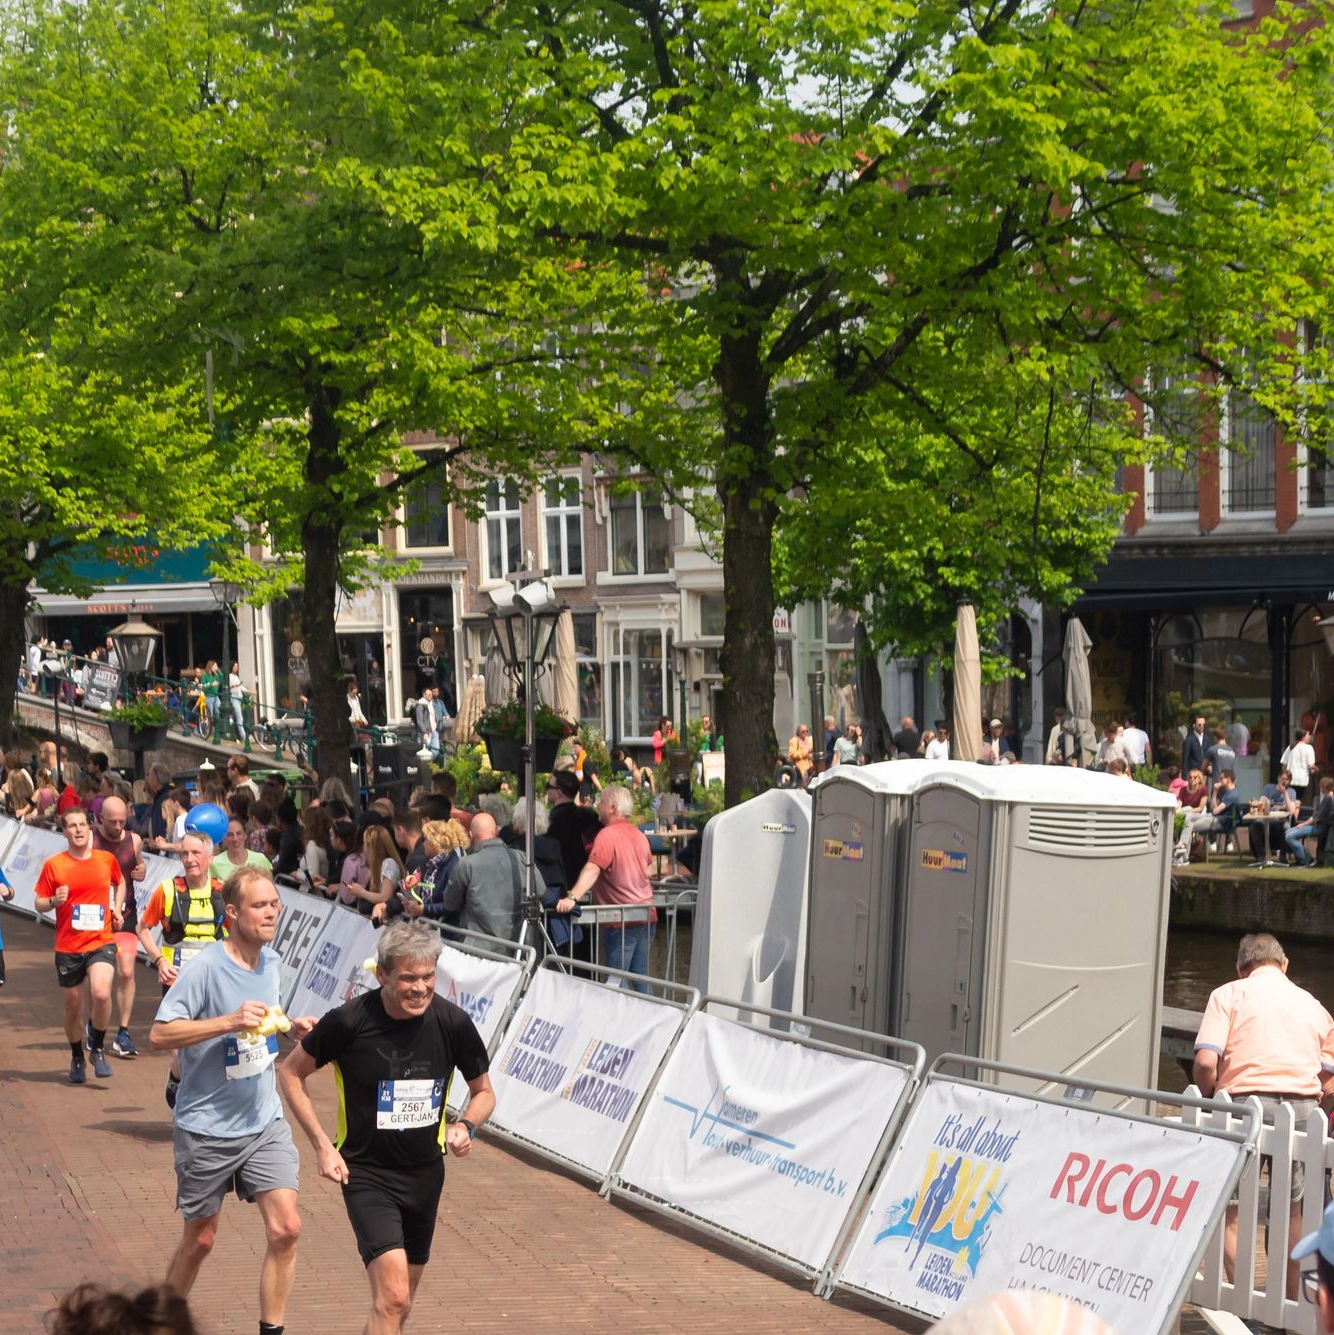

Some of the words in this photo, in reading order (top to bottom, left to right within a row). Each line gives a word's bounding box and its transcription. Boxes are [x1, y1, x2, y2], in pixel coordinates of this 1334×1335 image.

[395, 573, 453, 584] OEKHANDEL
[288, 657, 309, 669] CTY
[417, 656, 438, 667] CTY
[519, 1016, 564, 1055] LEIDEN
[505, 1045, 568, 1094] MARATHON
[587, 1039, 635, 1080] LEIDEN
[402, 1102, 425, 1113] 2567
[570, 1072, 639, 1124] MARATHON
[390, 1112, 433, 1123] GERT-JAN
[933, 1112, 963, 1149] It's
[956, 1115, 987, 1154] all
[974, 1119, 1021, 1163] about
[1049, 1151, 1200, 1232] RICOH
[924, 1252, 953, 1276] LEIDEN
[1019, 1242, 1101, 1284] DOCUMENT
[1097, 1265, 1154, 1303] CENTER
[916, 1271, 965, 1301] MARATHON
